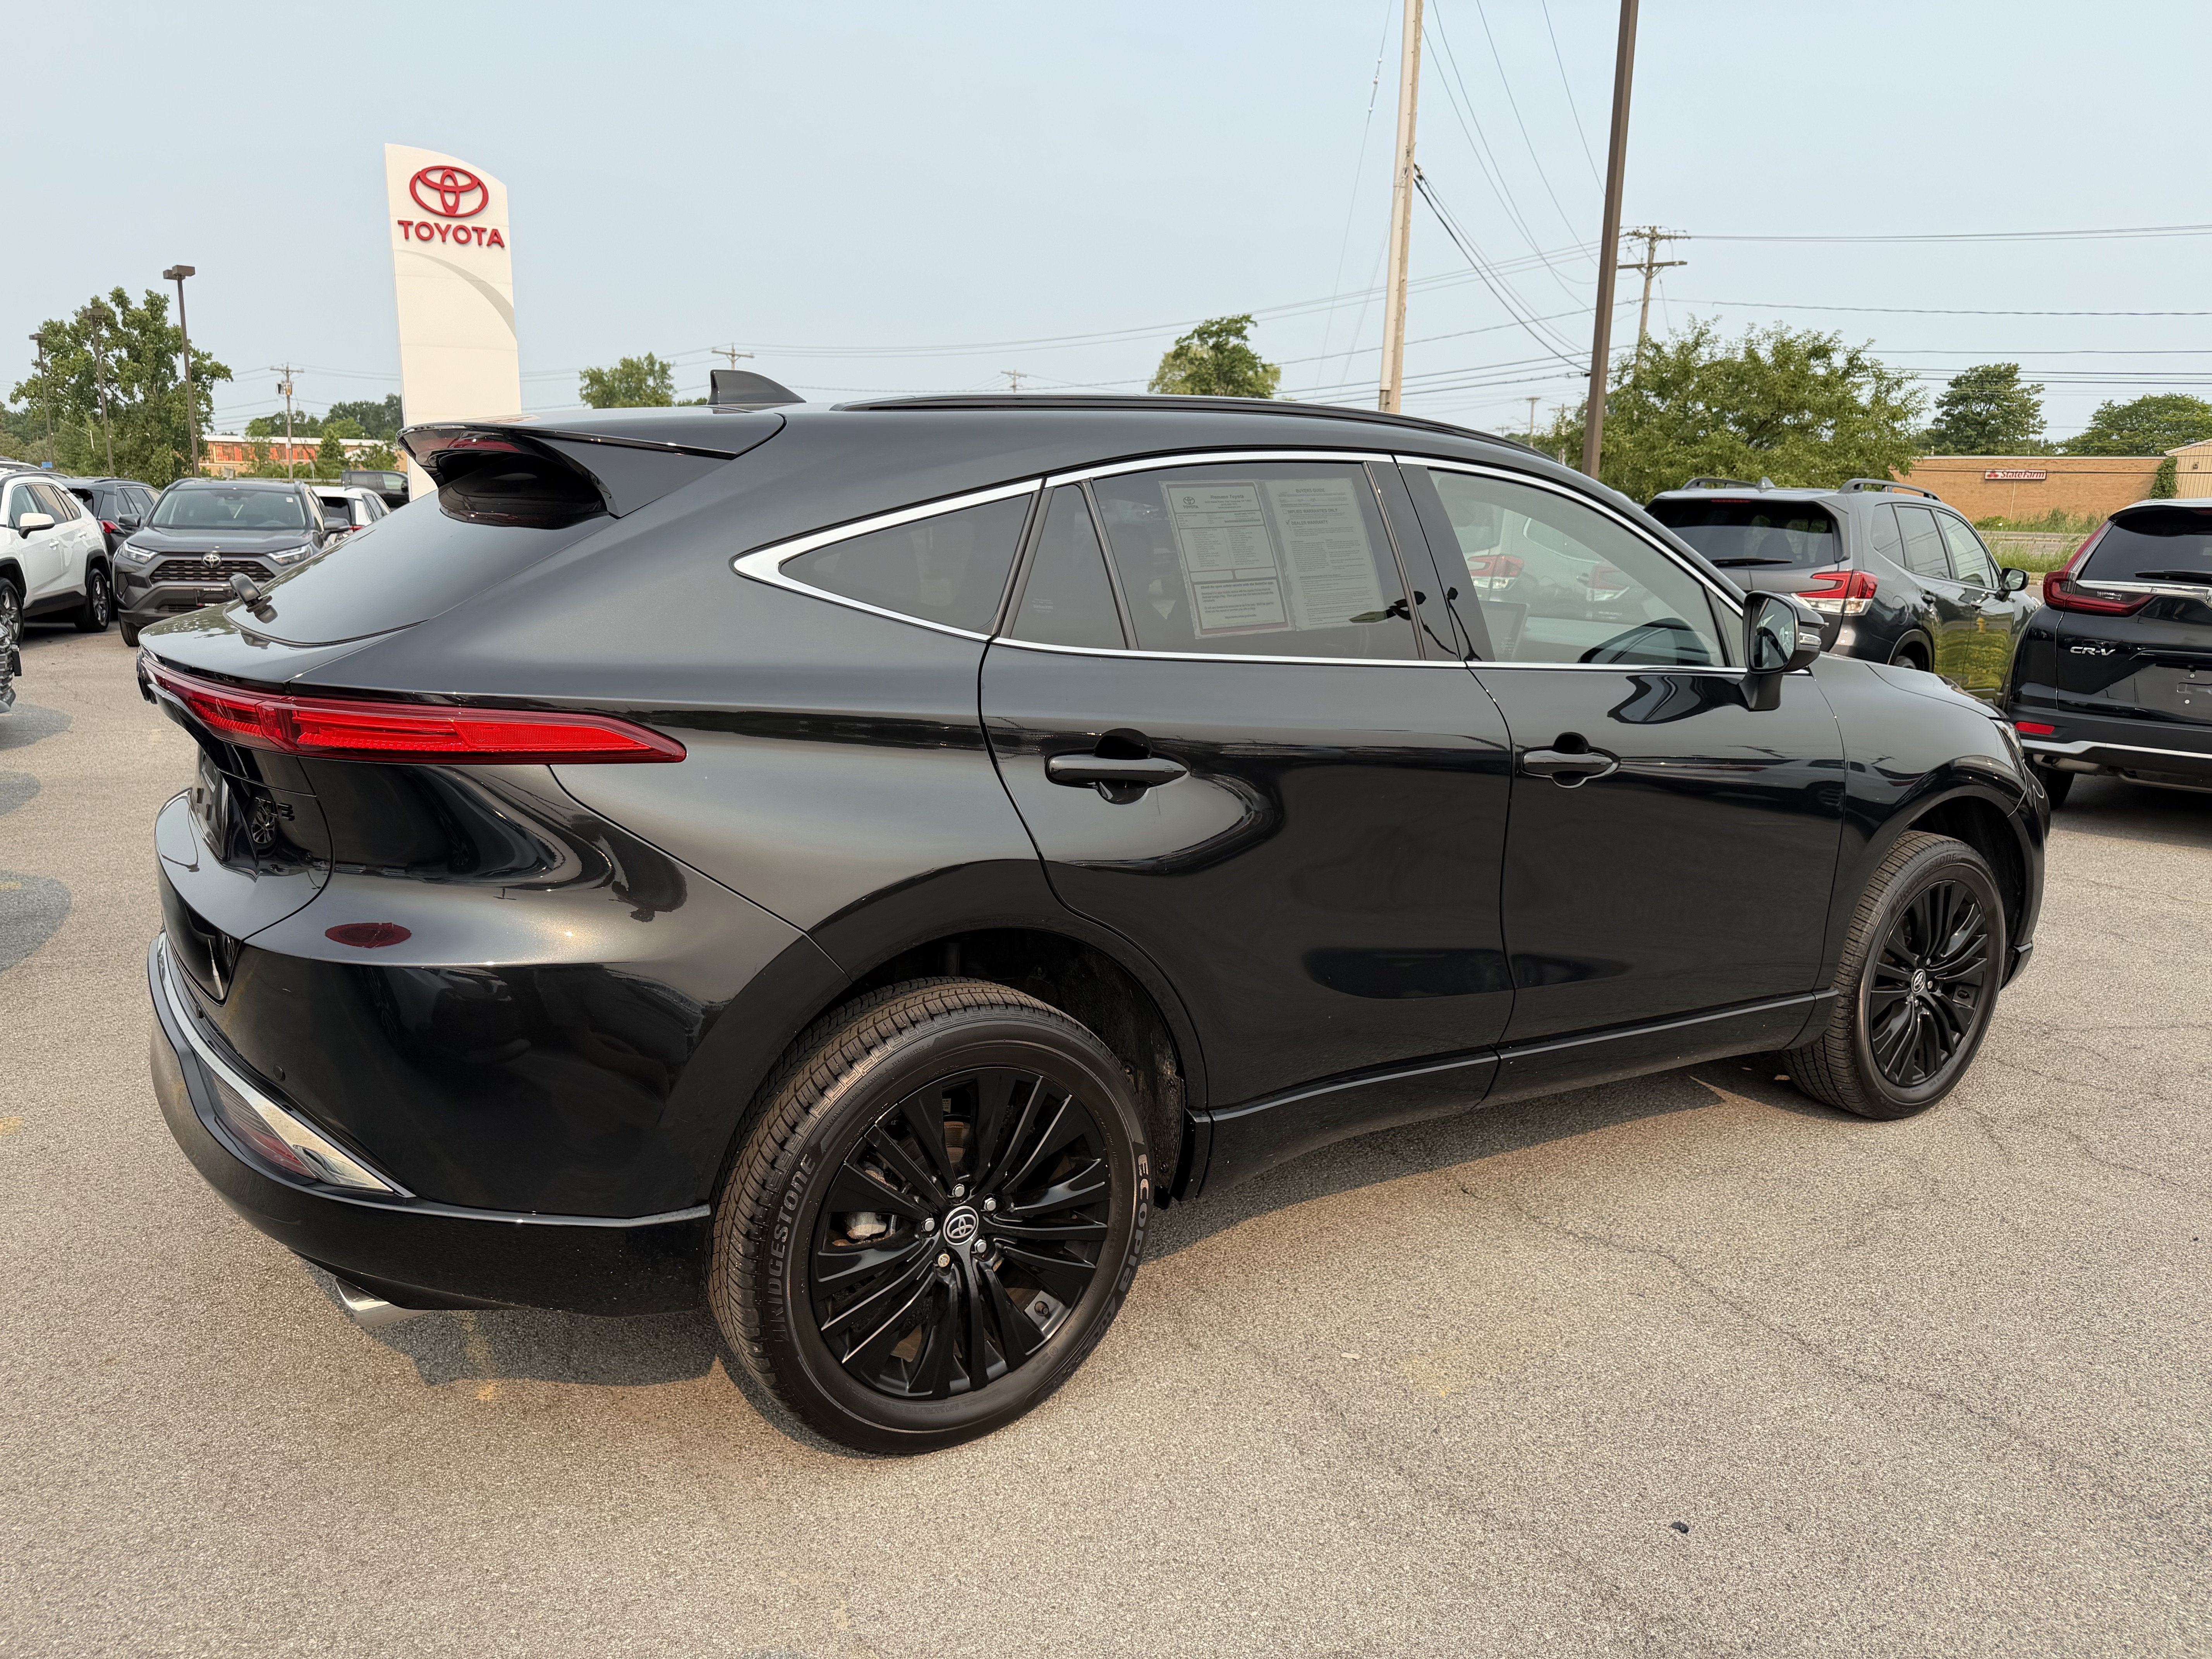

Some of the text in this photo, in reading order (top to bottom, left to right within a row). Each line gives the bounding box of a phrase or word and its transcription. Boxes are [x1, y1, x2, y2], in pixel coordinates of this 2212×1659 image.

[397, 220, 505, 248] TOYOTA
[2070, 646, 2115, 657] CR-V
[768, 1153, 815, 1341] BRIDGESTONE
[1118, 1154, 1149, 1292] ECOPIA
